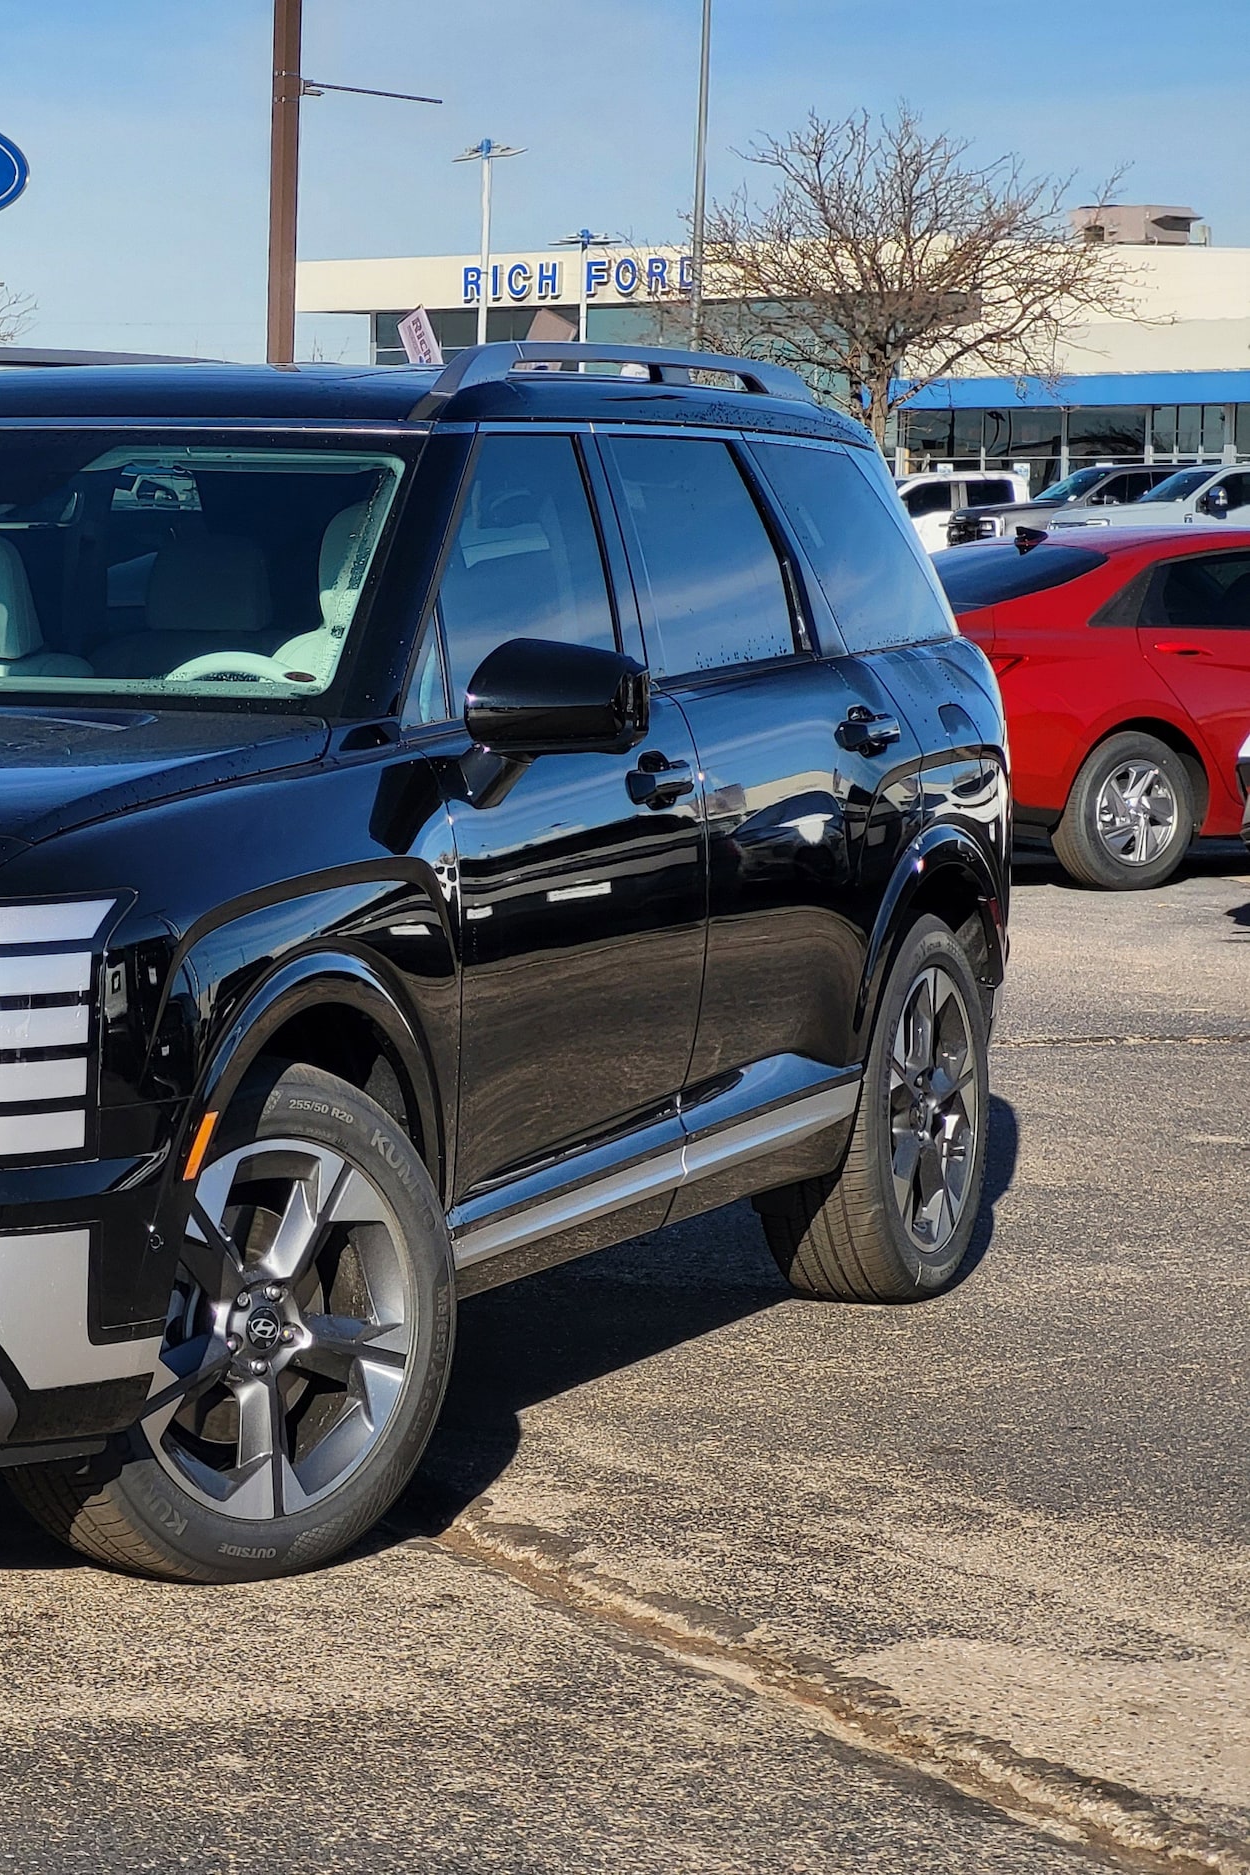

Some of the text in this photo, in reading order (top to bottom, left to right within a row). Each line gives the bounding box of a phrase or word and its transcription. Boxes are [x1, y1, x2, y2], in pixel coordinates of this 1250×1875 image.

[463, 256, 694, 301] RICH FORD
[289, 1099, 354, 1125] 255/50 R20
[218, 1542, 277, 1559] OUTSIDE
